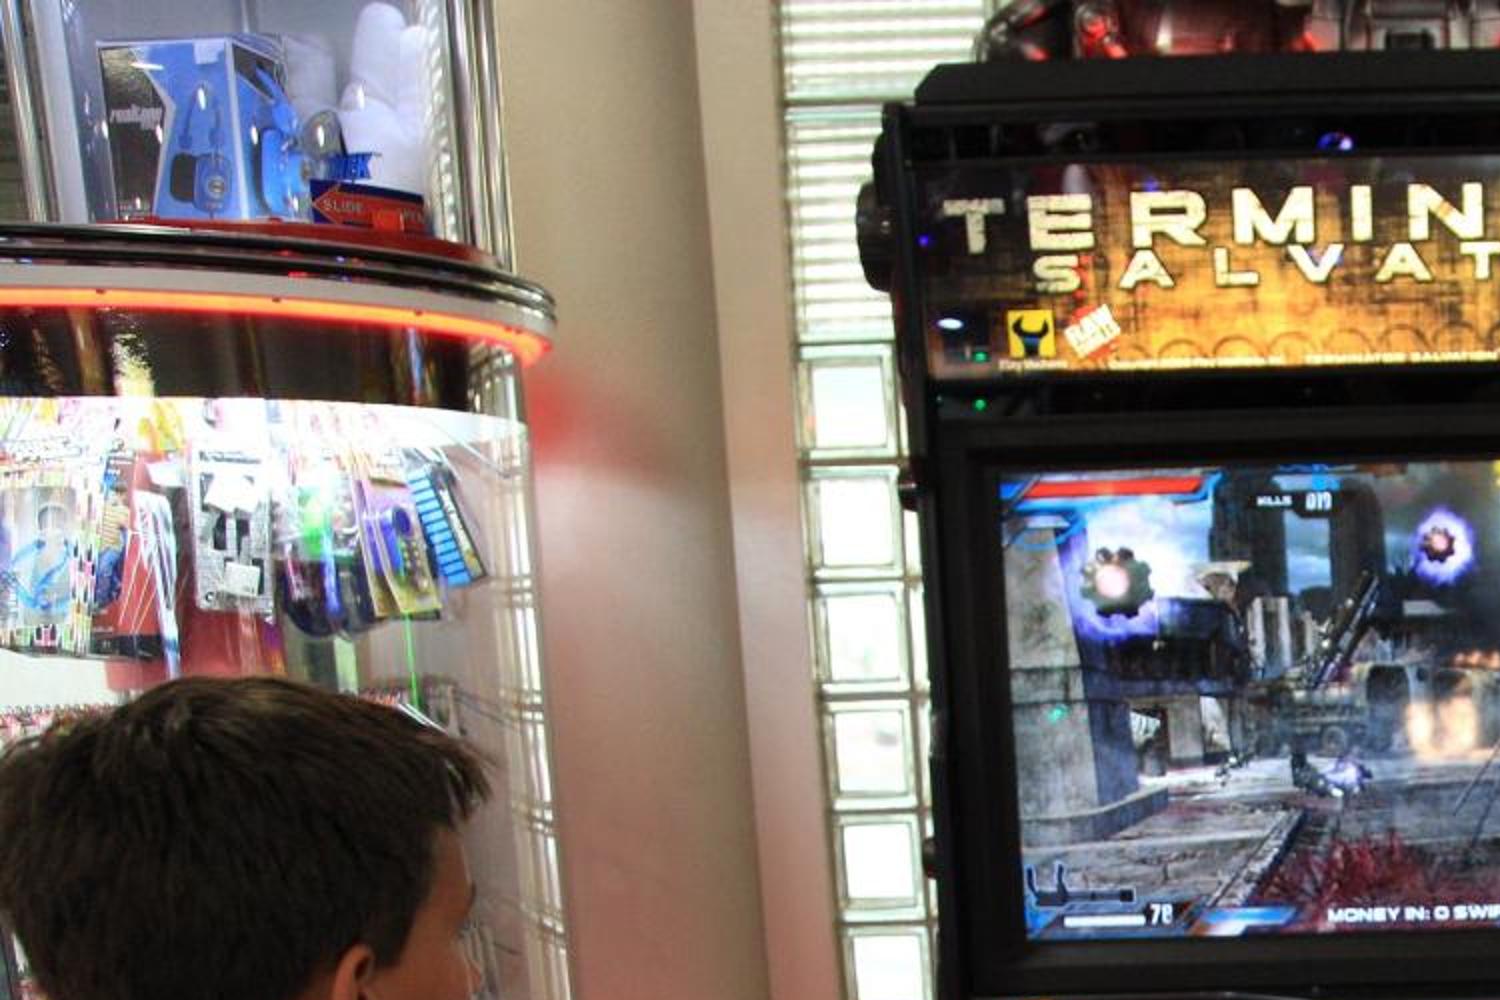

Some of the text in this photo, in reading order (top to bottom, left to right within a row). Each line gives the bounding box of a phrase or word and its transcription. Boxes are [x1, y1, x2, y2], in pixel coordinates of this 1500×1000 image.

[1149, 903, 1174, 925] 78
[1327, 907, 1400, 923] MONEY
[1404, 906, 1431, 921] IN:
